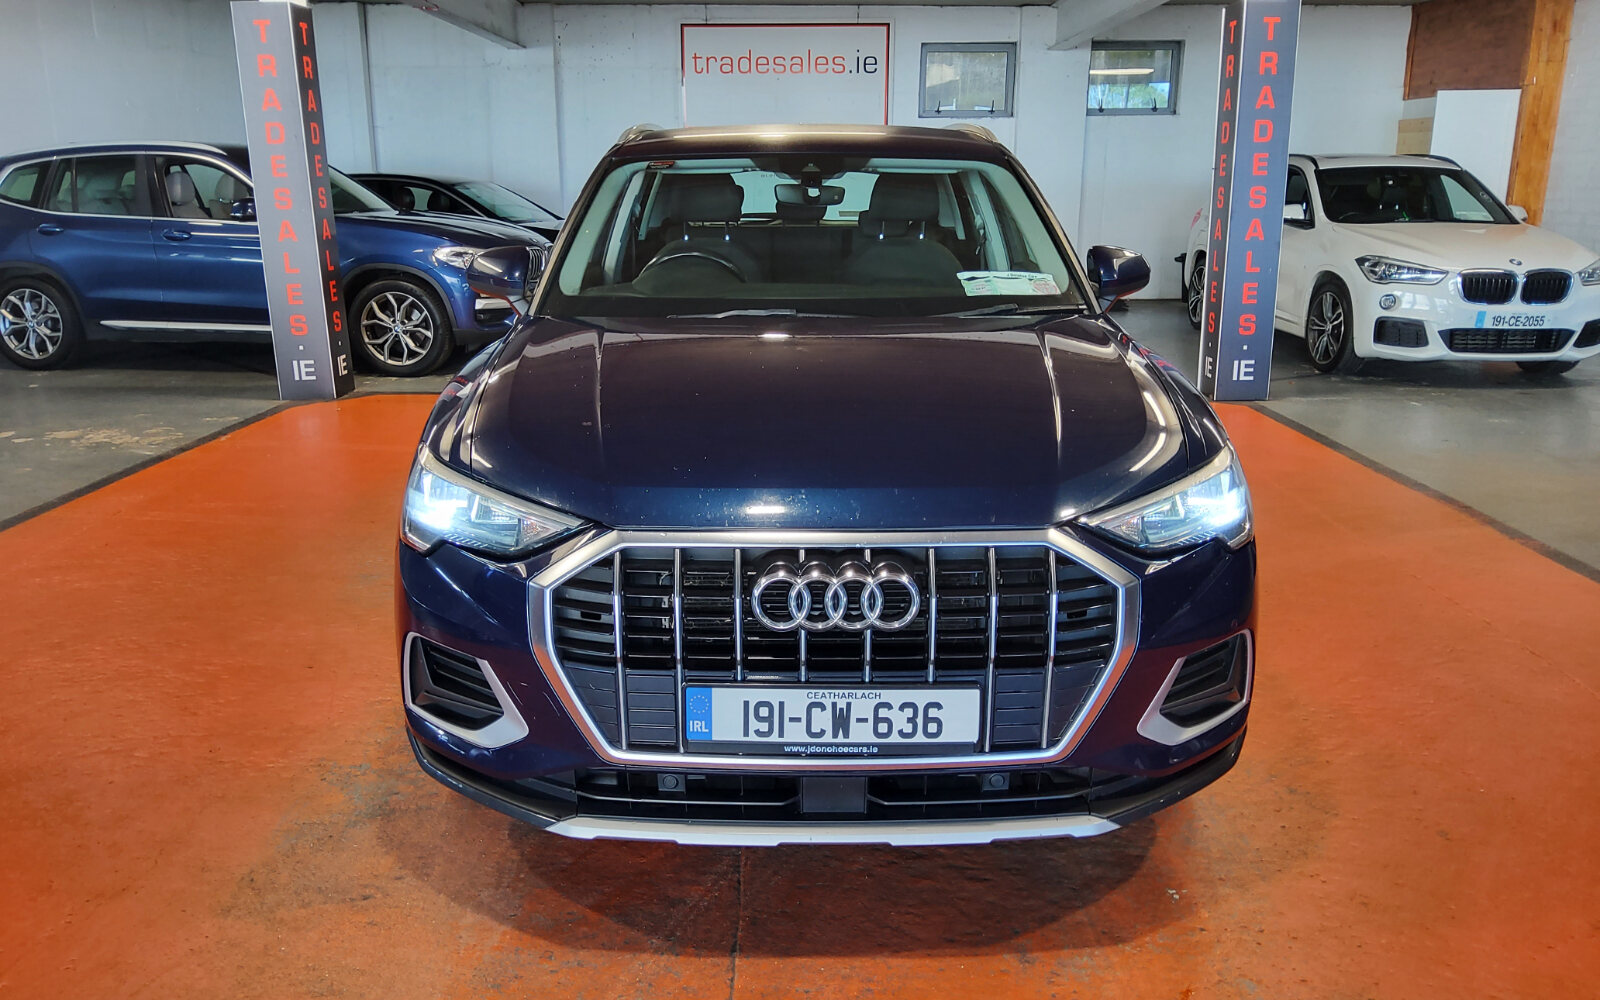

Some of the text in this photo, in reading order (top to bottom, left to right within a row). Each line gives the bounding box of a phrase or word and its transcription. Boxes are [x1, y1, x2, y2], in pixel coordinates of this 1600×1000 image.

[692, 49, 878, 75] tradesales.ie
[1492, 315, 1546, 327] 191-CE-2055
[806, 691, 881, 700] CEATHARLACH
[742, 700, 944, 740] 191-CW-636
[689, 720, 709, 733] IRL
[784, 745, 878, 754] www.jdonohoecars.ie
